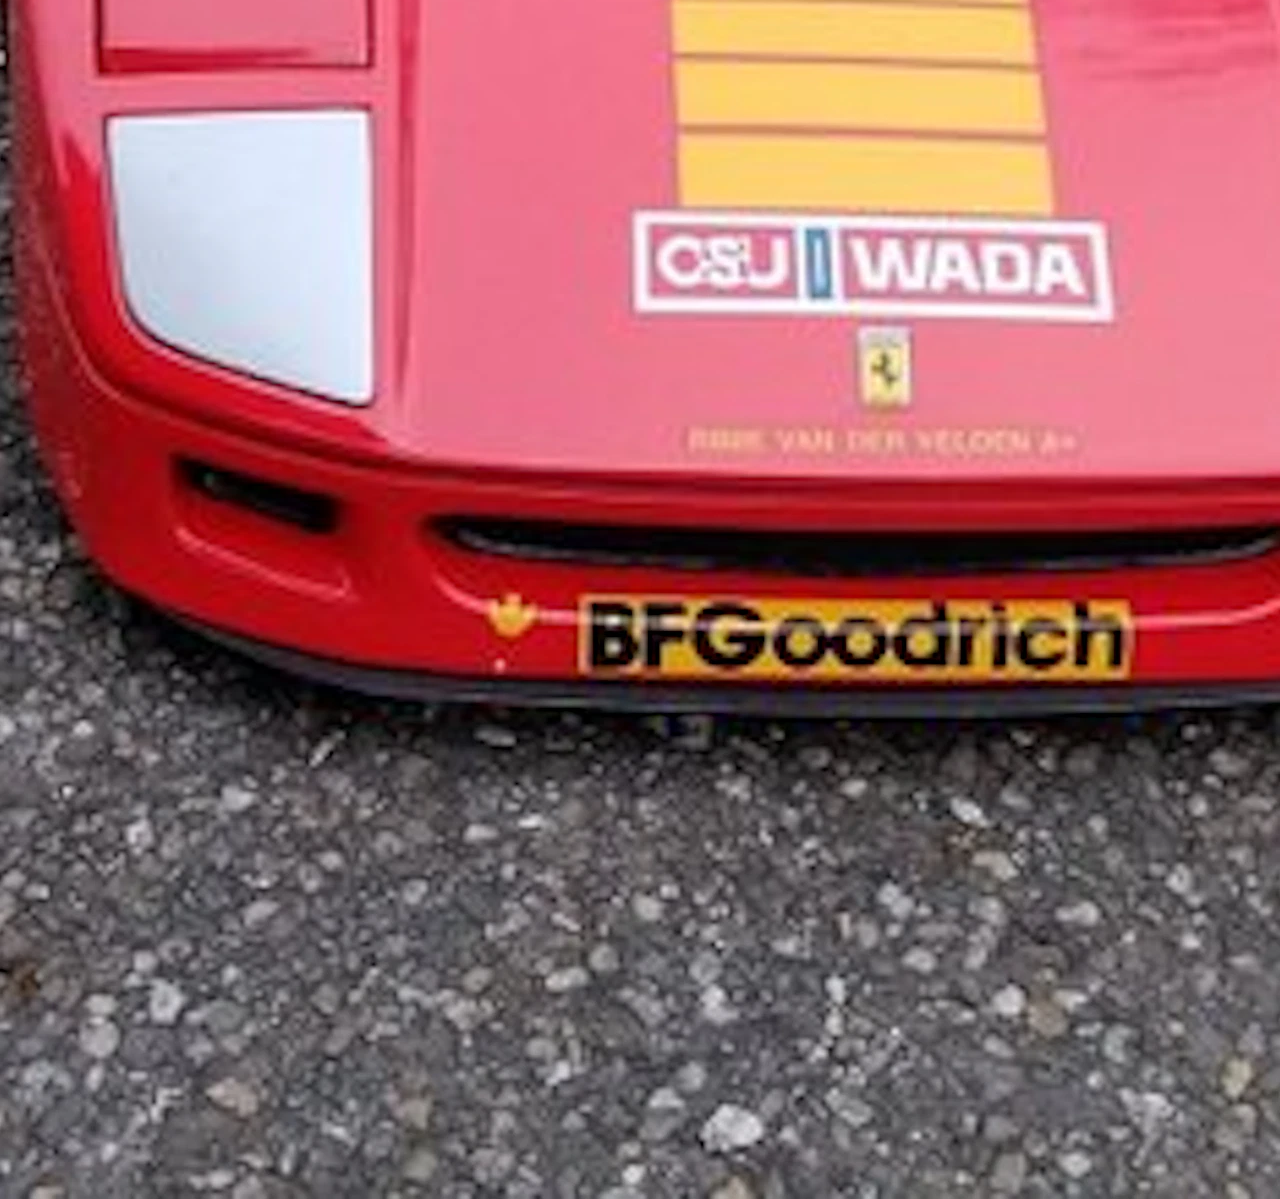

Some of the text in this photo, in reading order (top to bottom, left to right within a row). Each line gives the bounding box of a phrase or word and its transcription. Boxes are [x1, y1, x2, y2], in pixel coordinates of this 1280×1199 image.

[847, 236, 1087, 296] WADA
[775, 427, 835, 454] VAN
[587, 600, 1125, 672] BFGoodrich
